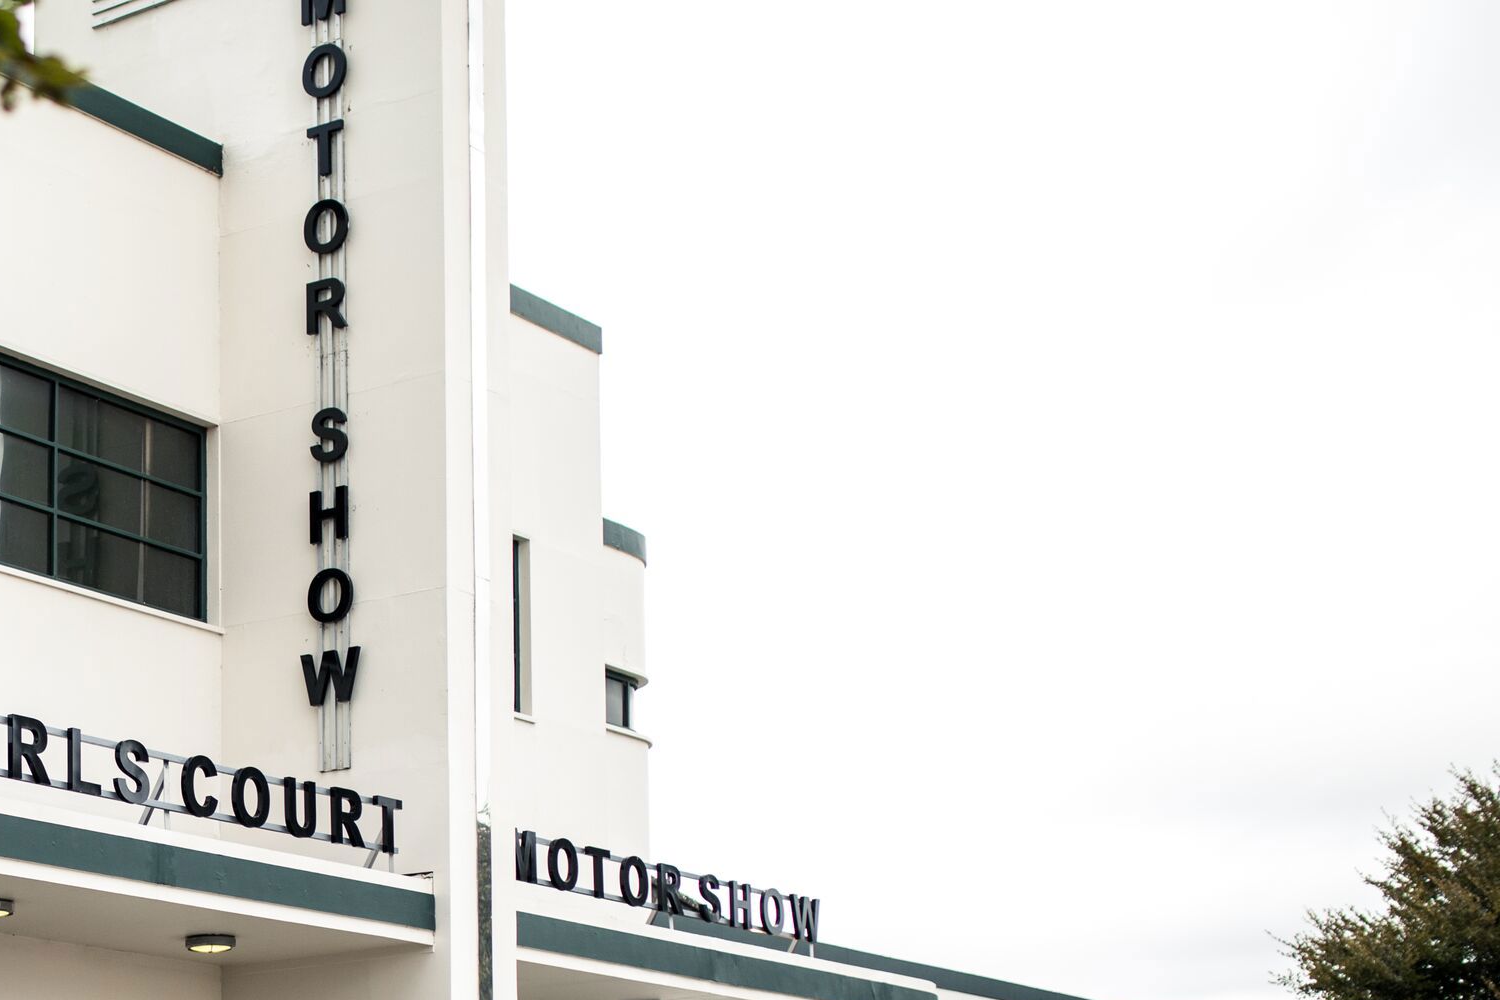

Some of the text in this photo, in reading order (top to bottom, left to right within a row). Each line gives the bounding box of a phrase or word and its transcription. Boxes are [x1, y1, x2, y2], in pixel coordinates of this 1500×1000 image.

[300, 407, 361, 707] SHOW
[181, 754, 403, 854] COURT
[515, 828, 820, 943] MOTOR SHOW
